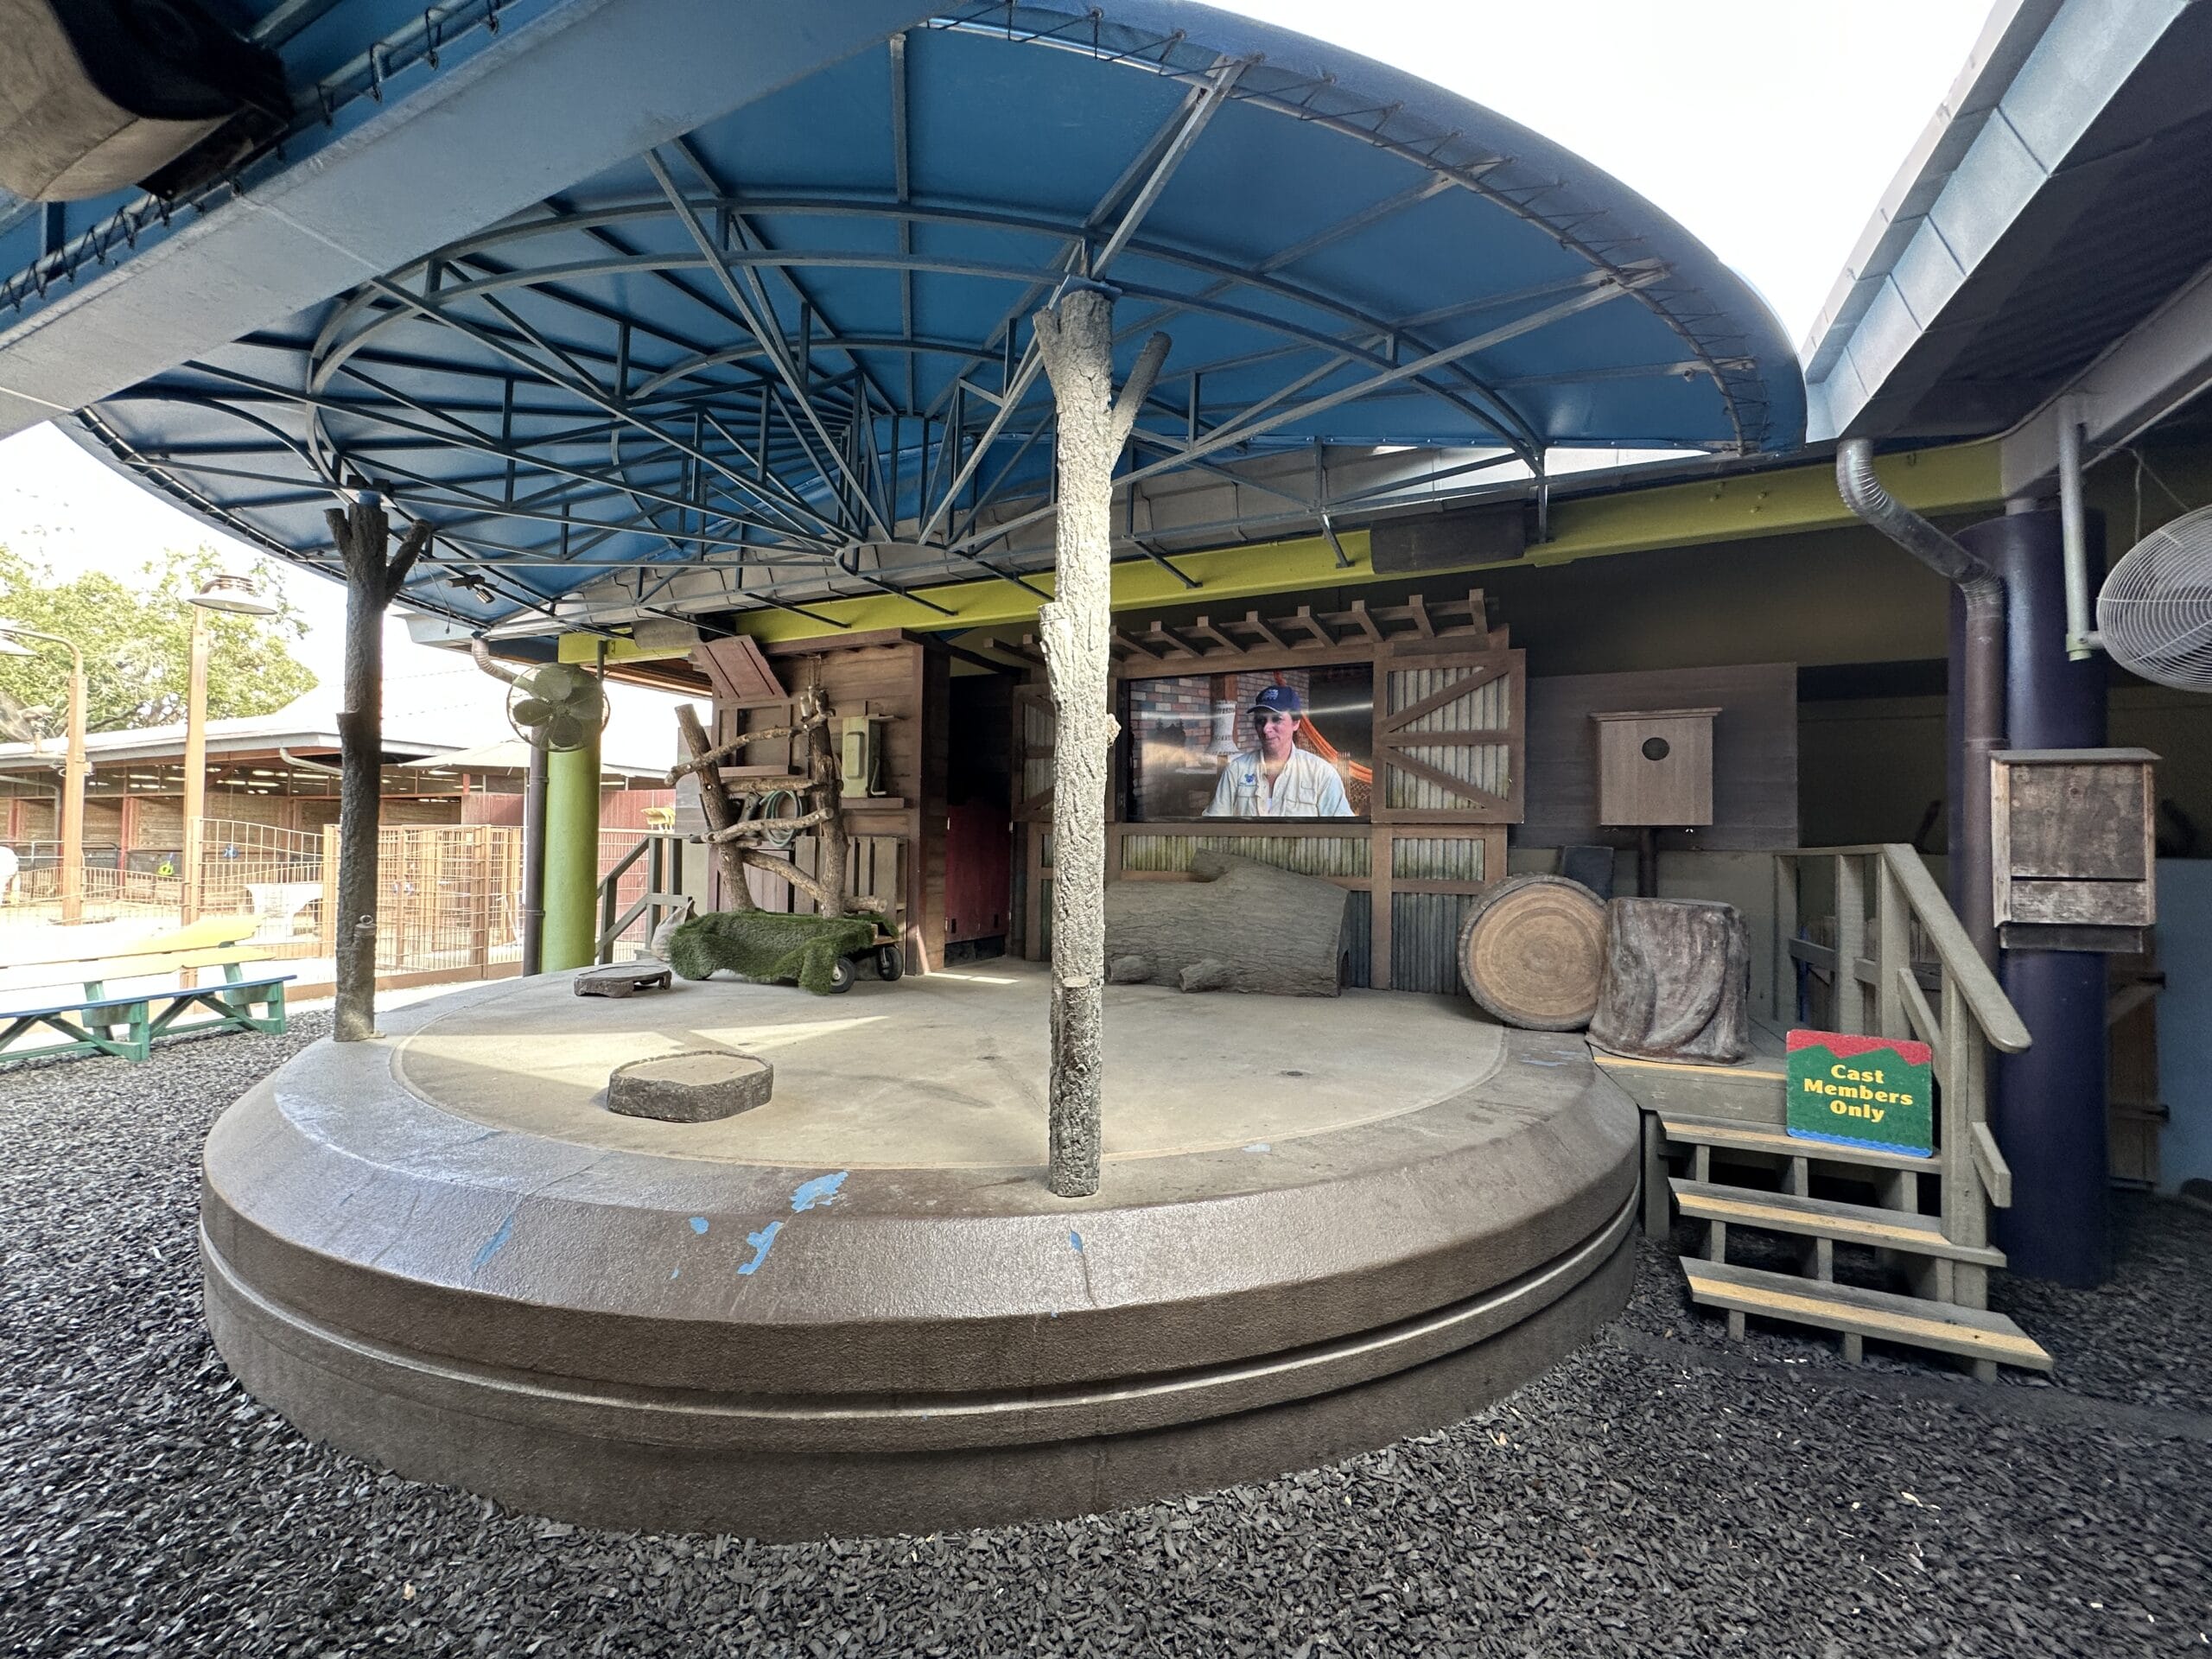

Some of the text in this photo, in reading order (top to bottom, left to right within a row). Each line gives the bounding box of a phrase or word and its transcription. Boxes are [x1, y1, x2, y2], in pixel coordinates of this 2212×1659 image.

[1830, 1065, 1885, 1084] Cast
[1803, 1078, 1914, 1106] Members
[1829, 1100, 1885, 1123] Only
